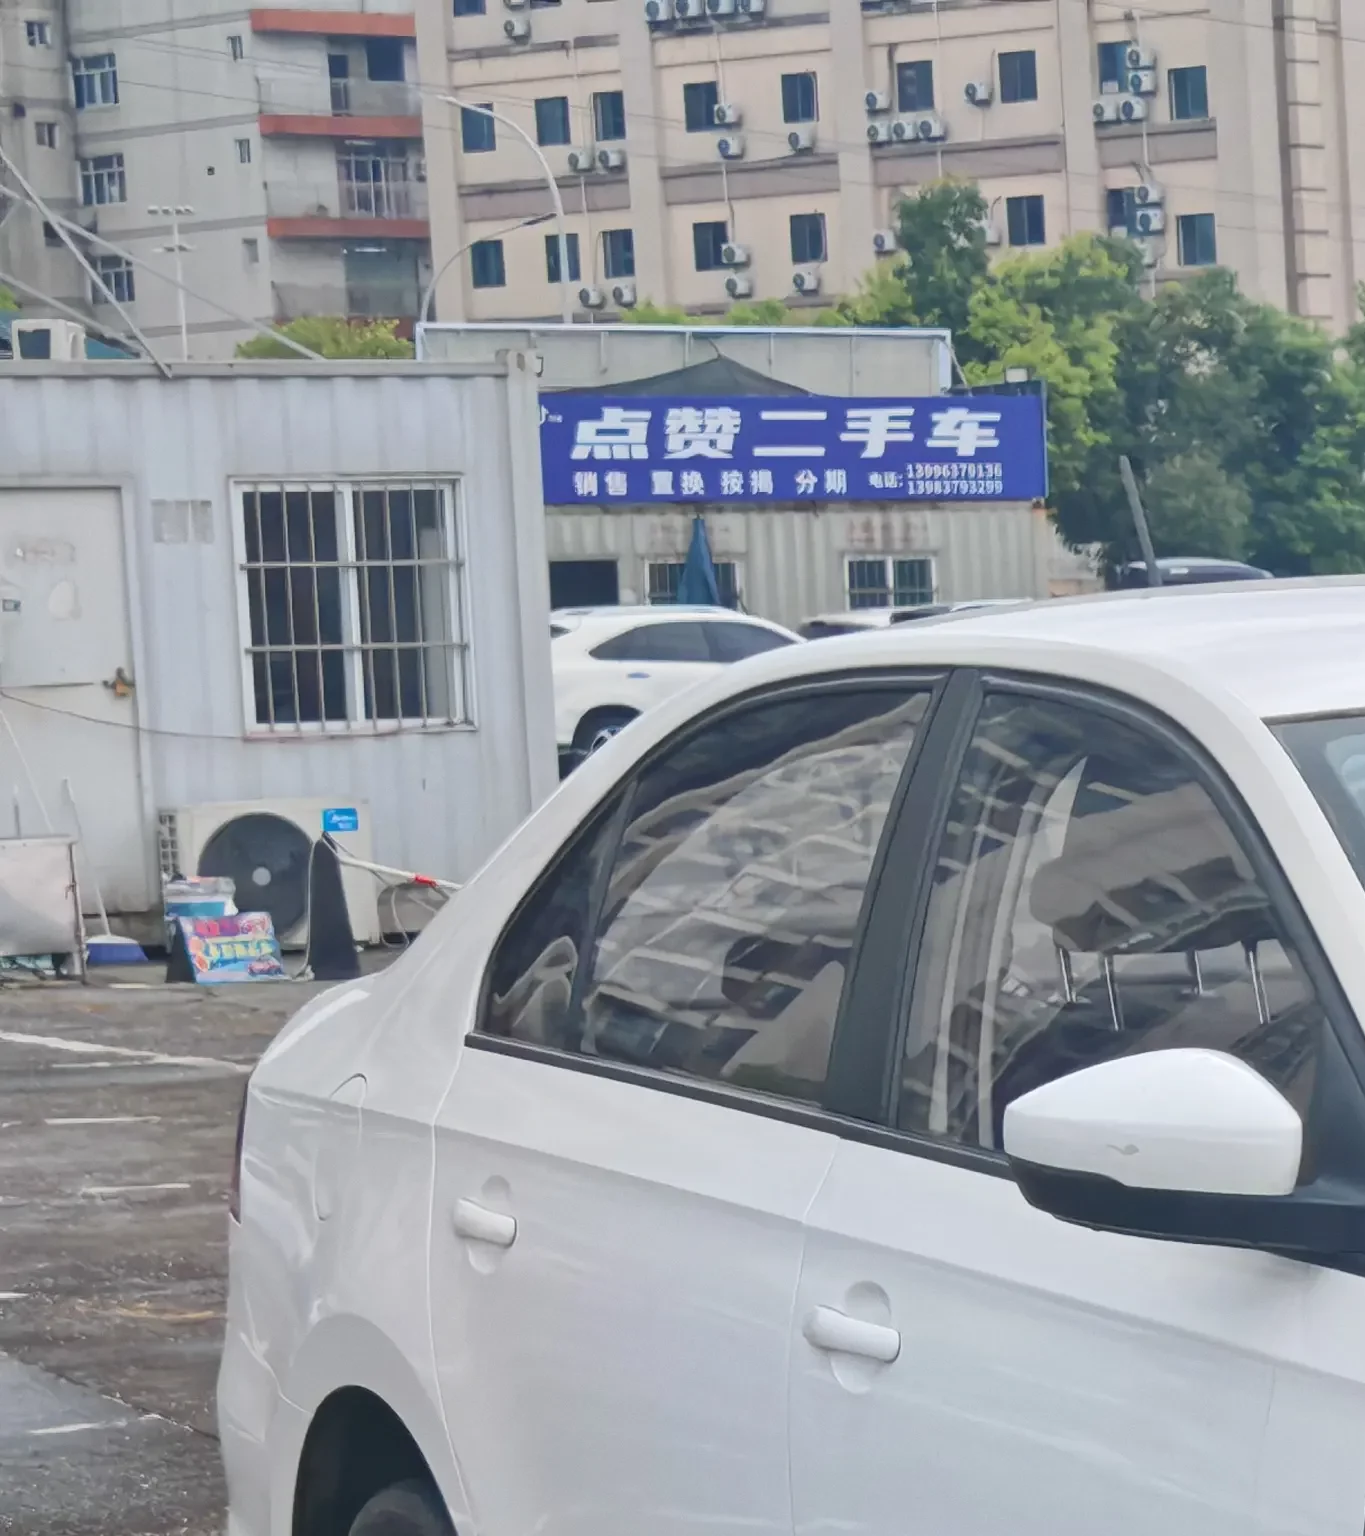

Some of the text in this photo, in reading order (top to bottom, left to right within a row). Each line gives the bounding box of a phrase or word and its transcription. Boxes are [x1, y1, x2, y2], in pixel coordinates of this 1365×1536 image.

[570, 407, 1002, 460] 点赞二手车
[574, 471, 628, 497] 销售
[651, 470, 705, 496] 置换
[795, 468, 847, 495] 分期
